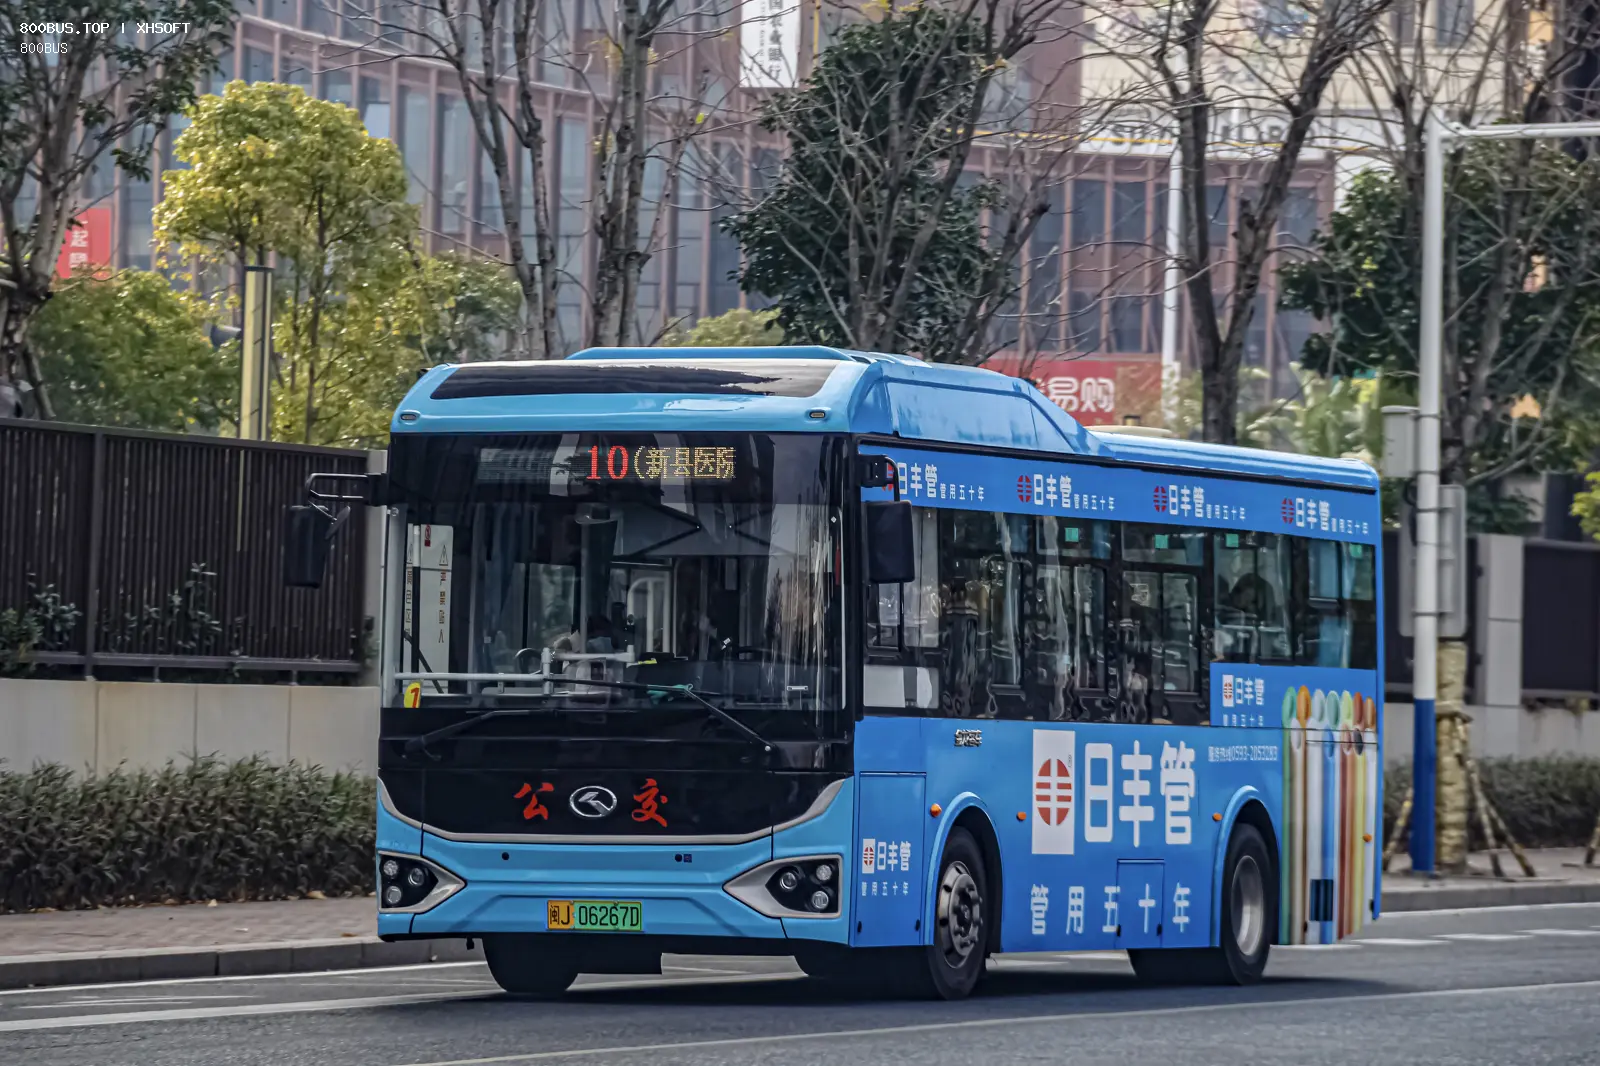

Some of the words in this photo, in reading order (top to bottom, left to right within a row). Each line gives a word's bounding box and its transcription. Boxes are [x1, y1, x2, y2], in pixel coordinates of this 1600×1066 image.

[1037, 377, 1114, 412] 易购
[1033, 473, 1071, 508] 日丰管
[1084, 740, 1195, 848] 日丰管
[877, 841, 911, 872] 日丰管
[1030, 882, 1190, 935] 管用五十年
